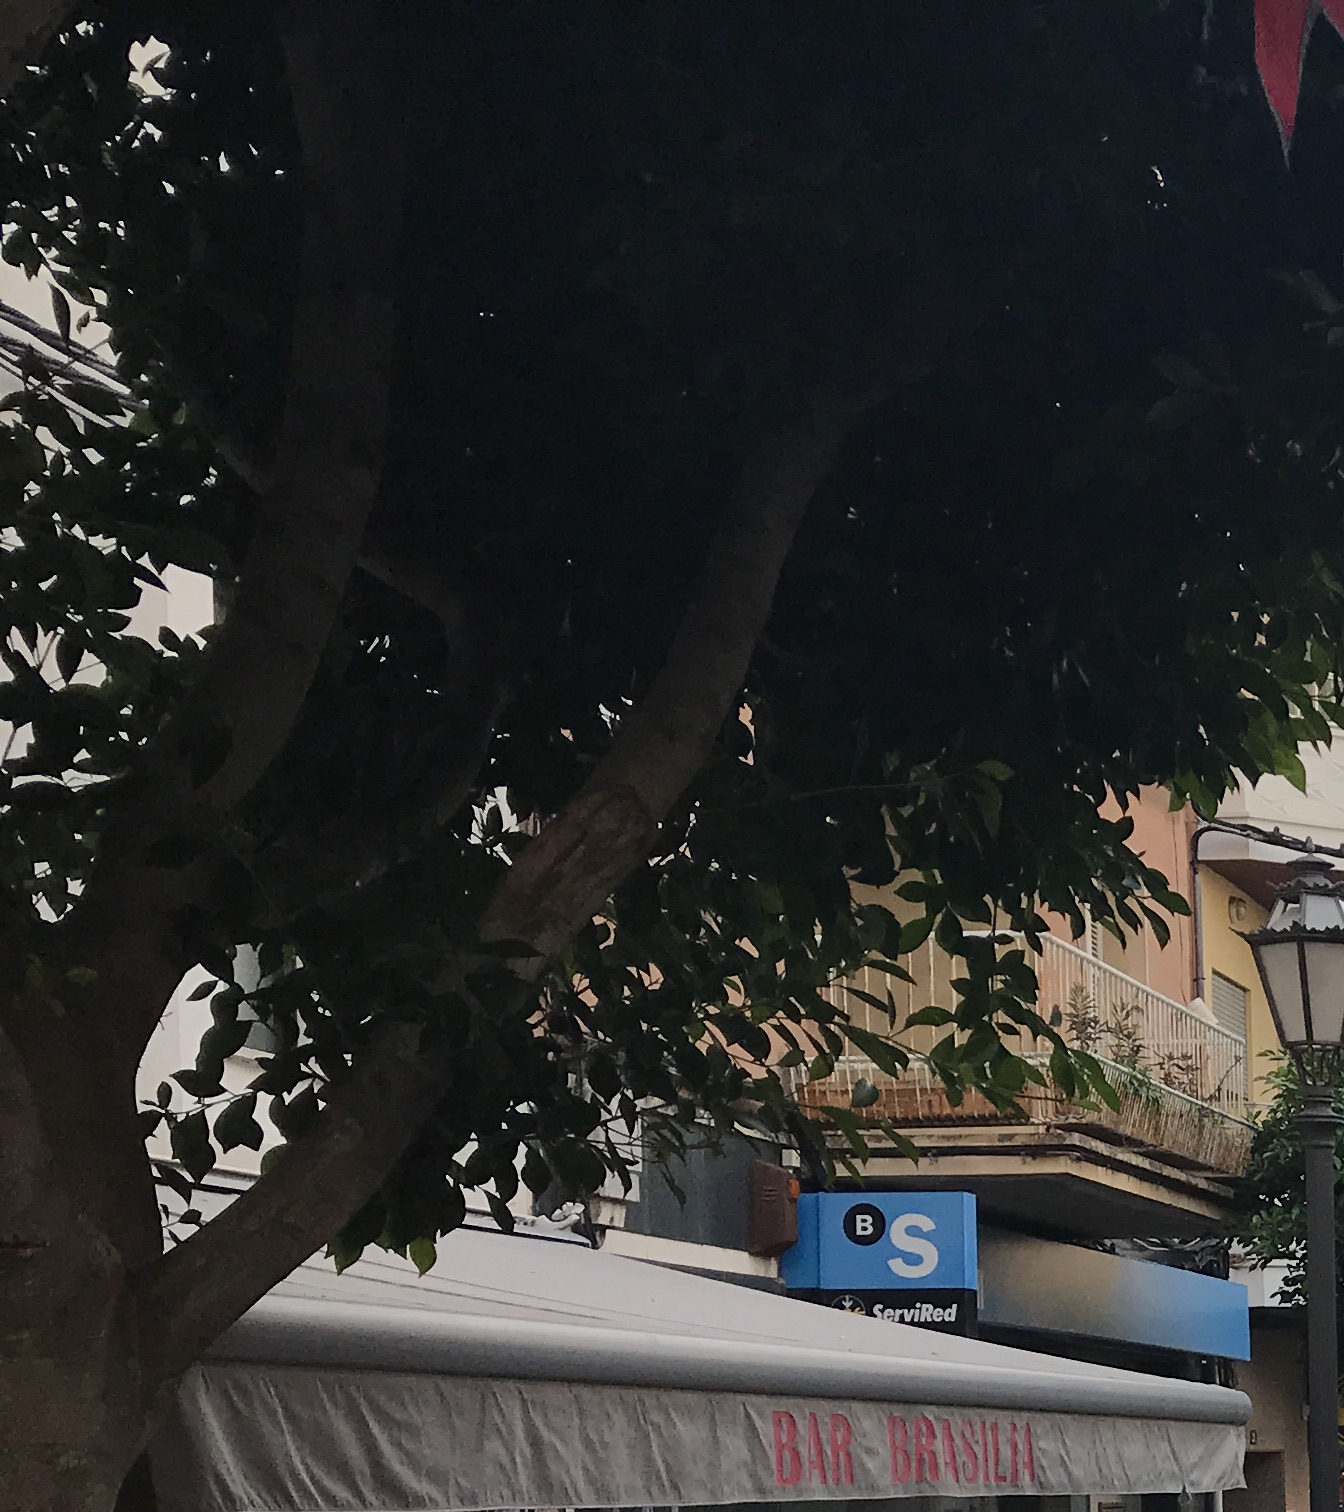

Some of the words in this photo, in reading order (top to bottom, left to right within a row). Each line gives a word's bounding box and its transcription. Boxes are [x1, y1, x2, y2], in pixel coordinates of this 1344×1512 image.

[872, 1302, 958, 1322] ServiRed
[771, 1410, 854, 1487] BAR
[887, 1415, 1036, 1485] BRASILIA
